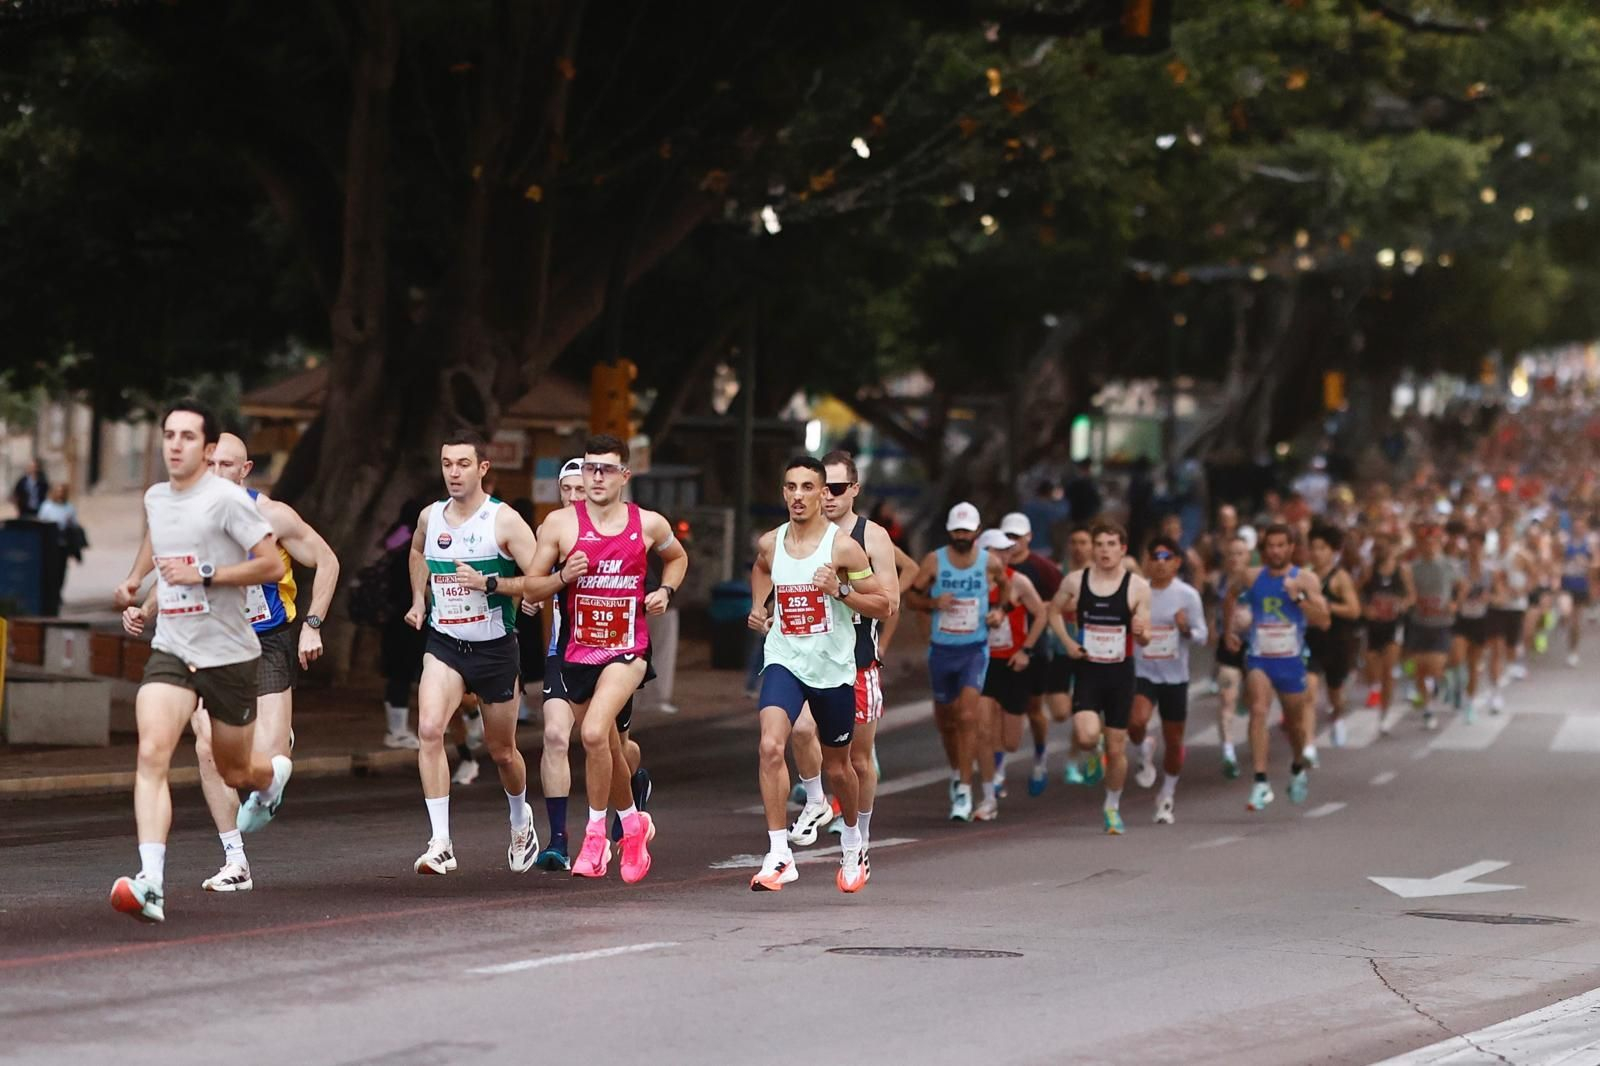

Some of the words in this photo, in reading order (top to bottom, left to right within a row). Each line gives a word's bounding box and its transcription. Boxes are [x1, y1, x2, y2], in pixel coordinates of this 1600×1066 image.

[597, 559, 622, 574] PEAK
[576, 575, 640, 590] PERFORMANCE
[941, 576, 982, 592] nerja
[441, 586, 471, 598] 14625
[590, 599, 627, 608] GENERALI
[788, 596, 808, 608] 252
[592, 610, 614, 622] 316
